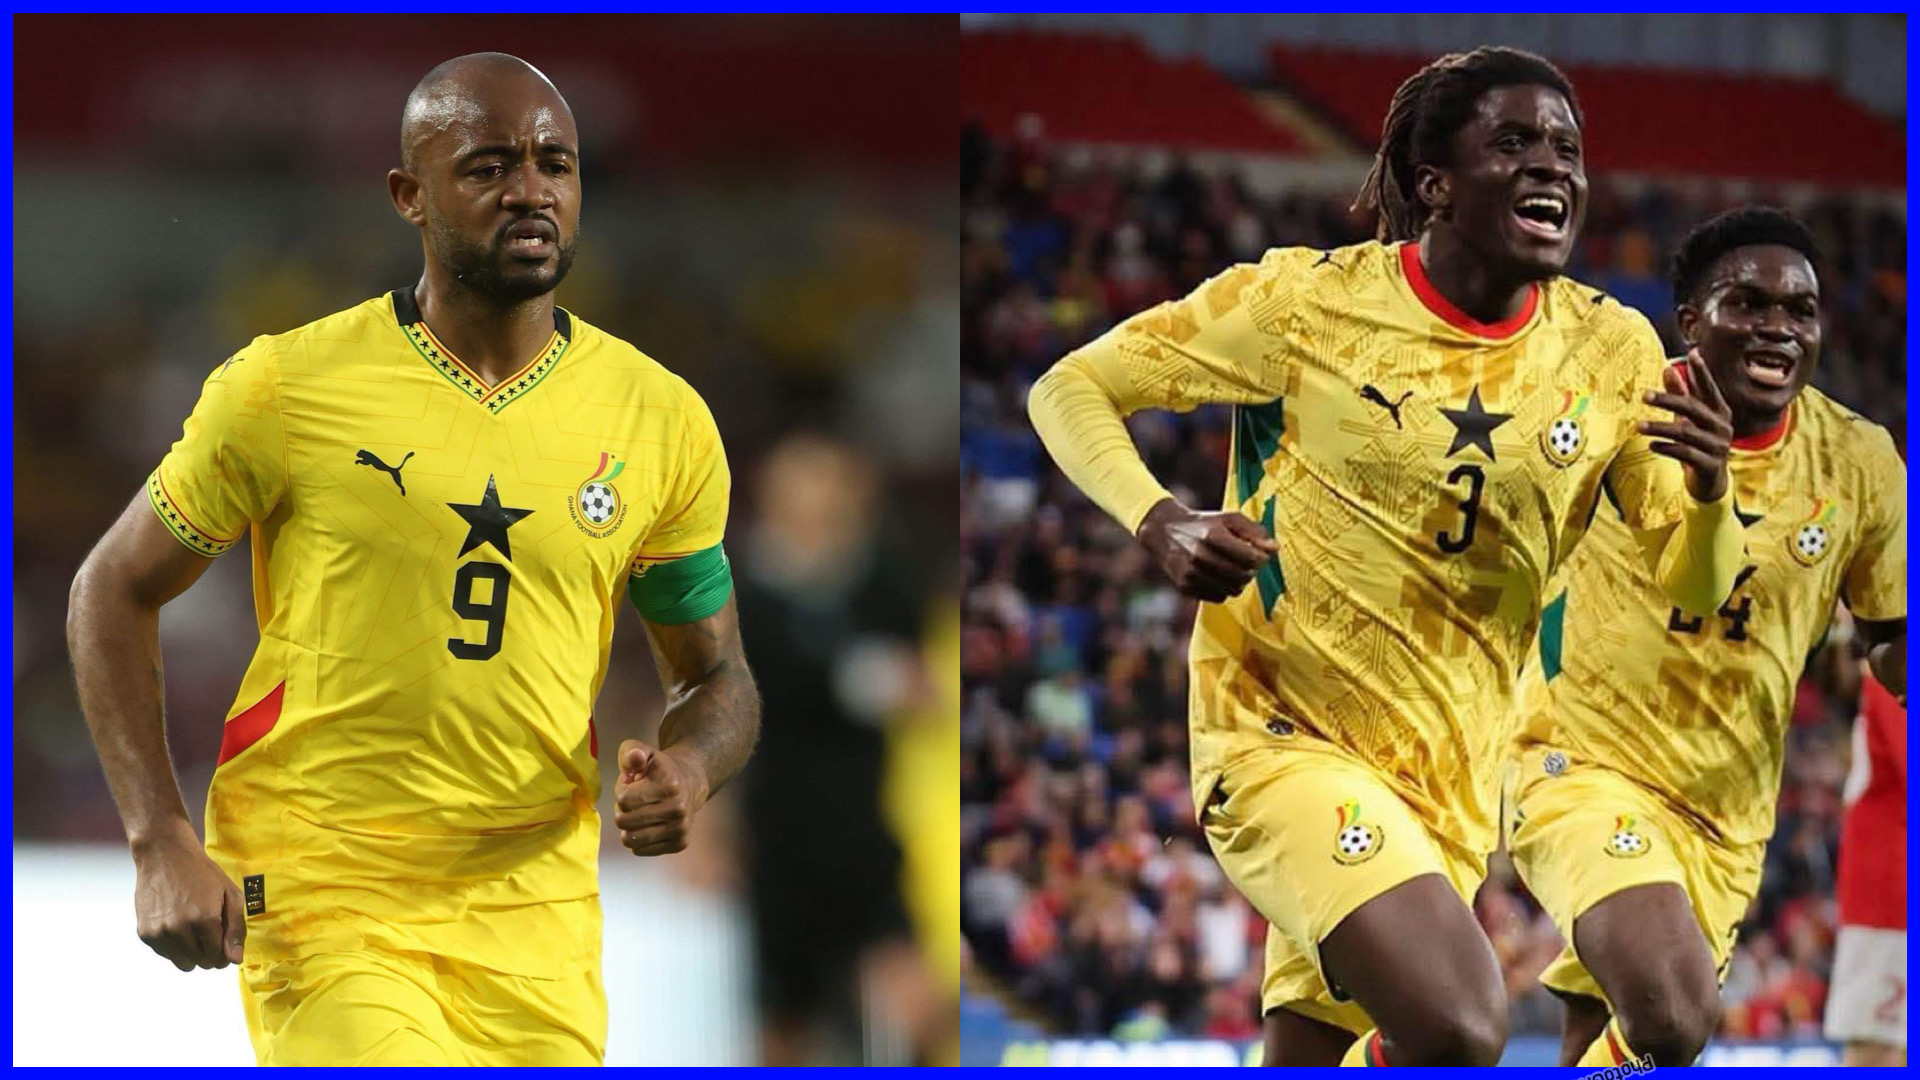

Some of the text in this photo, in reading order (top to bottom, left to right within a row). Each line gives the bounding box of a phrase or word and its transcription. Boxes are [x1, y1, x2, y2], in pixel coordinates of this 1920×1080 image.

[567, 495, 628, 539] GHANA FOOTBALL ASSOCIATION
[1436, 465, 1485, 553] 3
[447, 561, 512, 661] 9
[1668, 565, 1758, 641] 4
